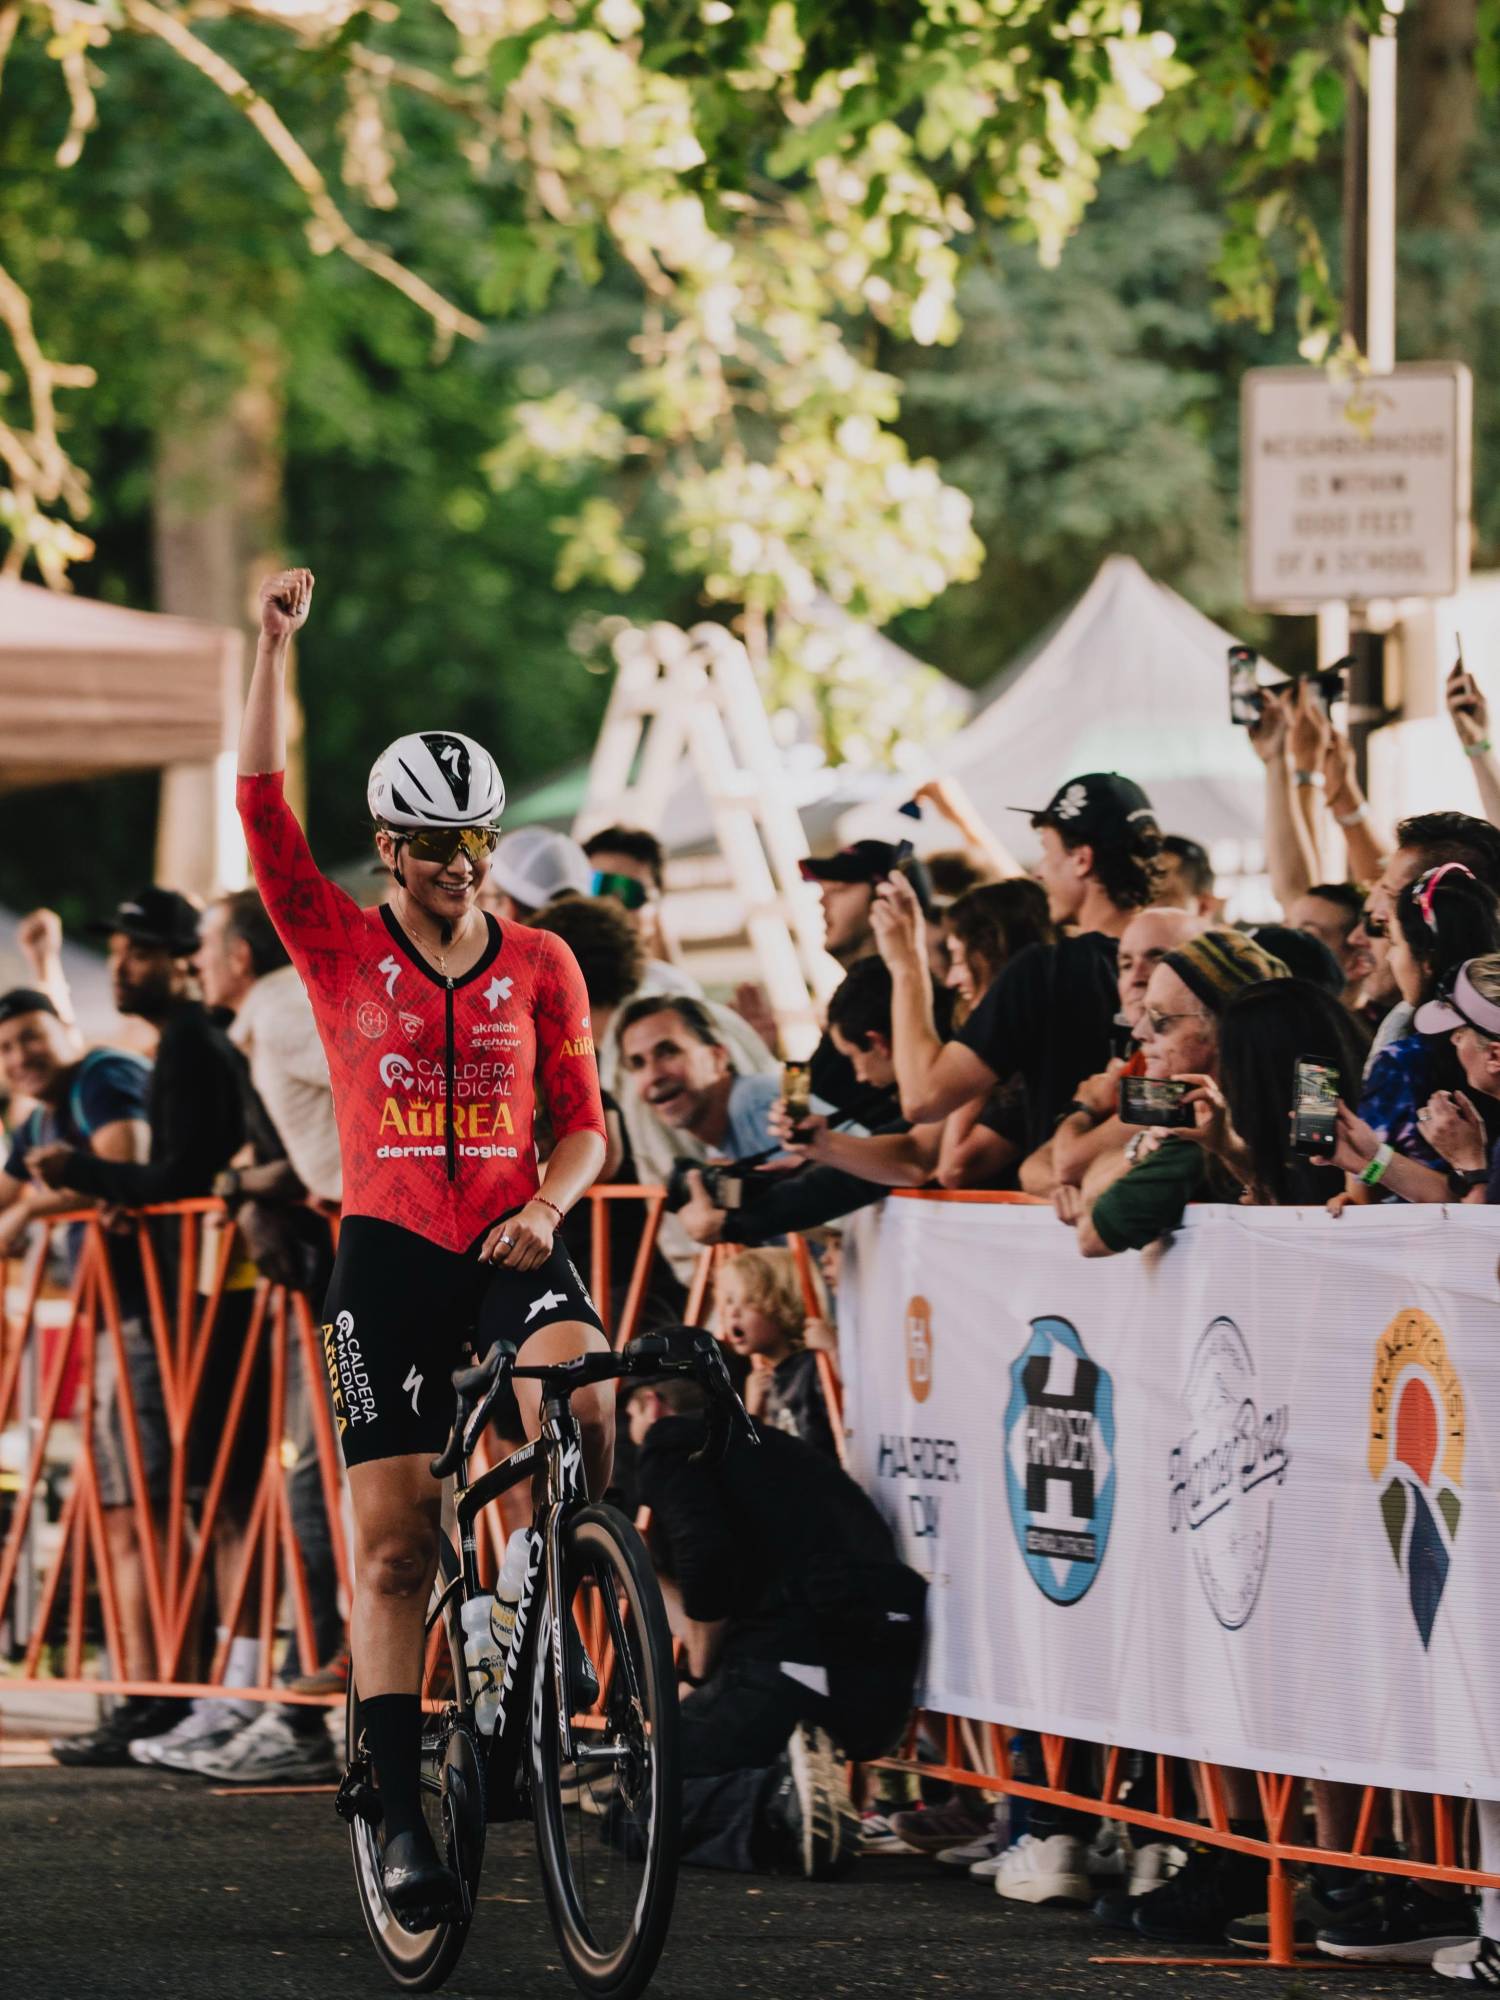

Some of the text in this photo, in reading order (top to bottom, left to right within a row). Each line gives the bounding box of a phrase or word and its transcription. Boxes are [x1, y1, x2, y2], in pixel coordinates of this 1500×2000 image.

[416, 1059, 516, 1080] CALDERA
[416, 1079, 513, 1098] MEDICAL
[337, 1342, 363, 1428] MEDICAL
[347, 1338, 379, 1424] CALDERA
[877, 1433, 960, 1483] HARDER
[1024, 1404, 1096, 1471] HARDER
